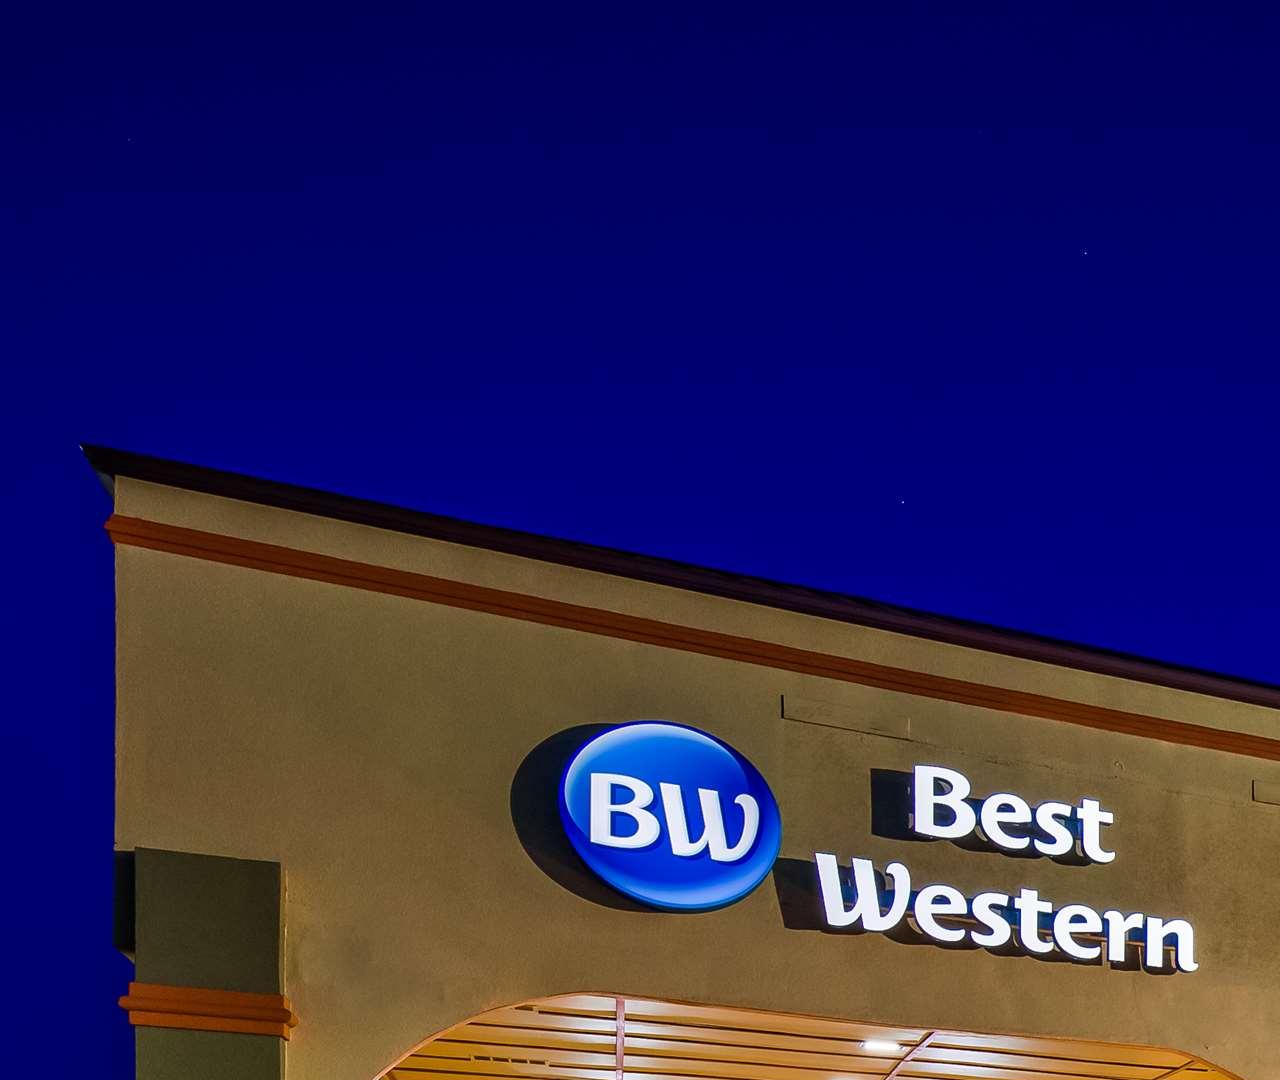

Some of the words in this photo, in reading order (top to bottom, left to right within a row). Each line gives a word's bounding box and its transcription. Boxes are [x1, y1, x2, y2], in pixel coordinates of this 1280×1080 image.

[589, 771, 760, 863] BW
[914, 765, 1116, 863] Best
[814, 852, 1199, 973] Western
